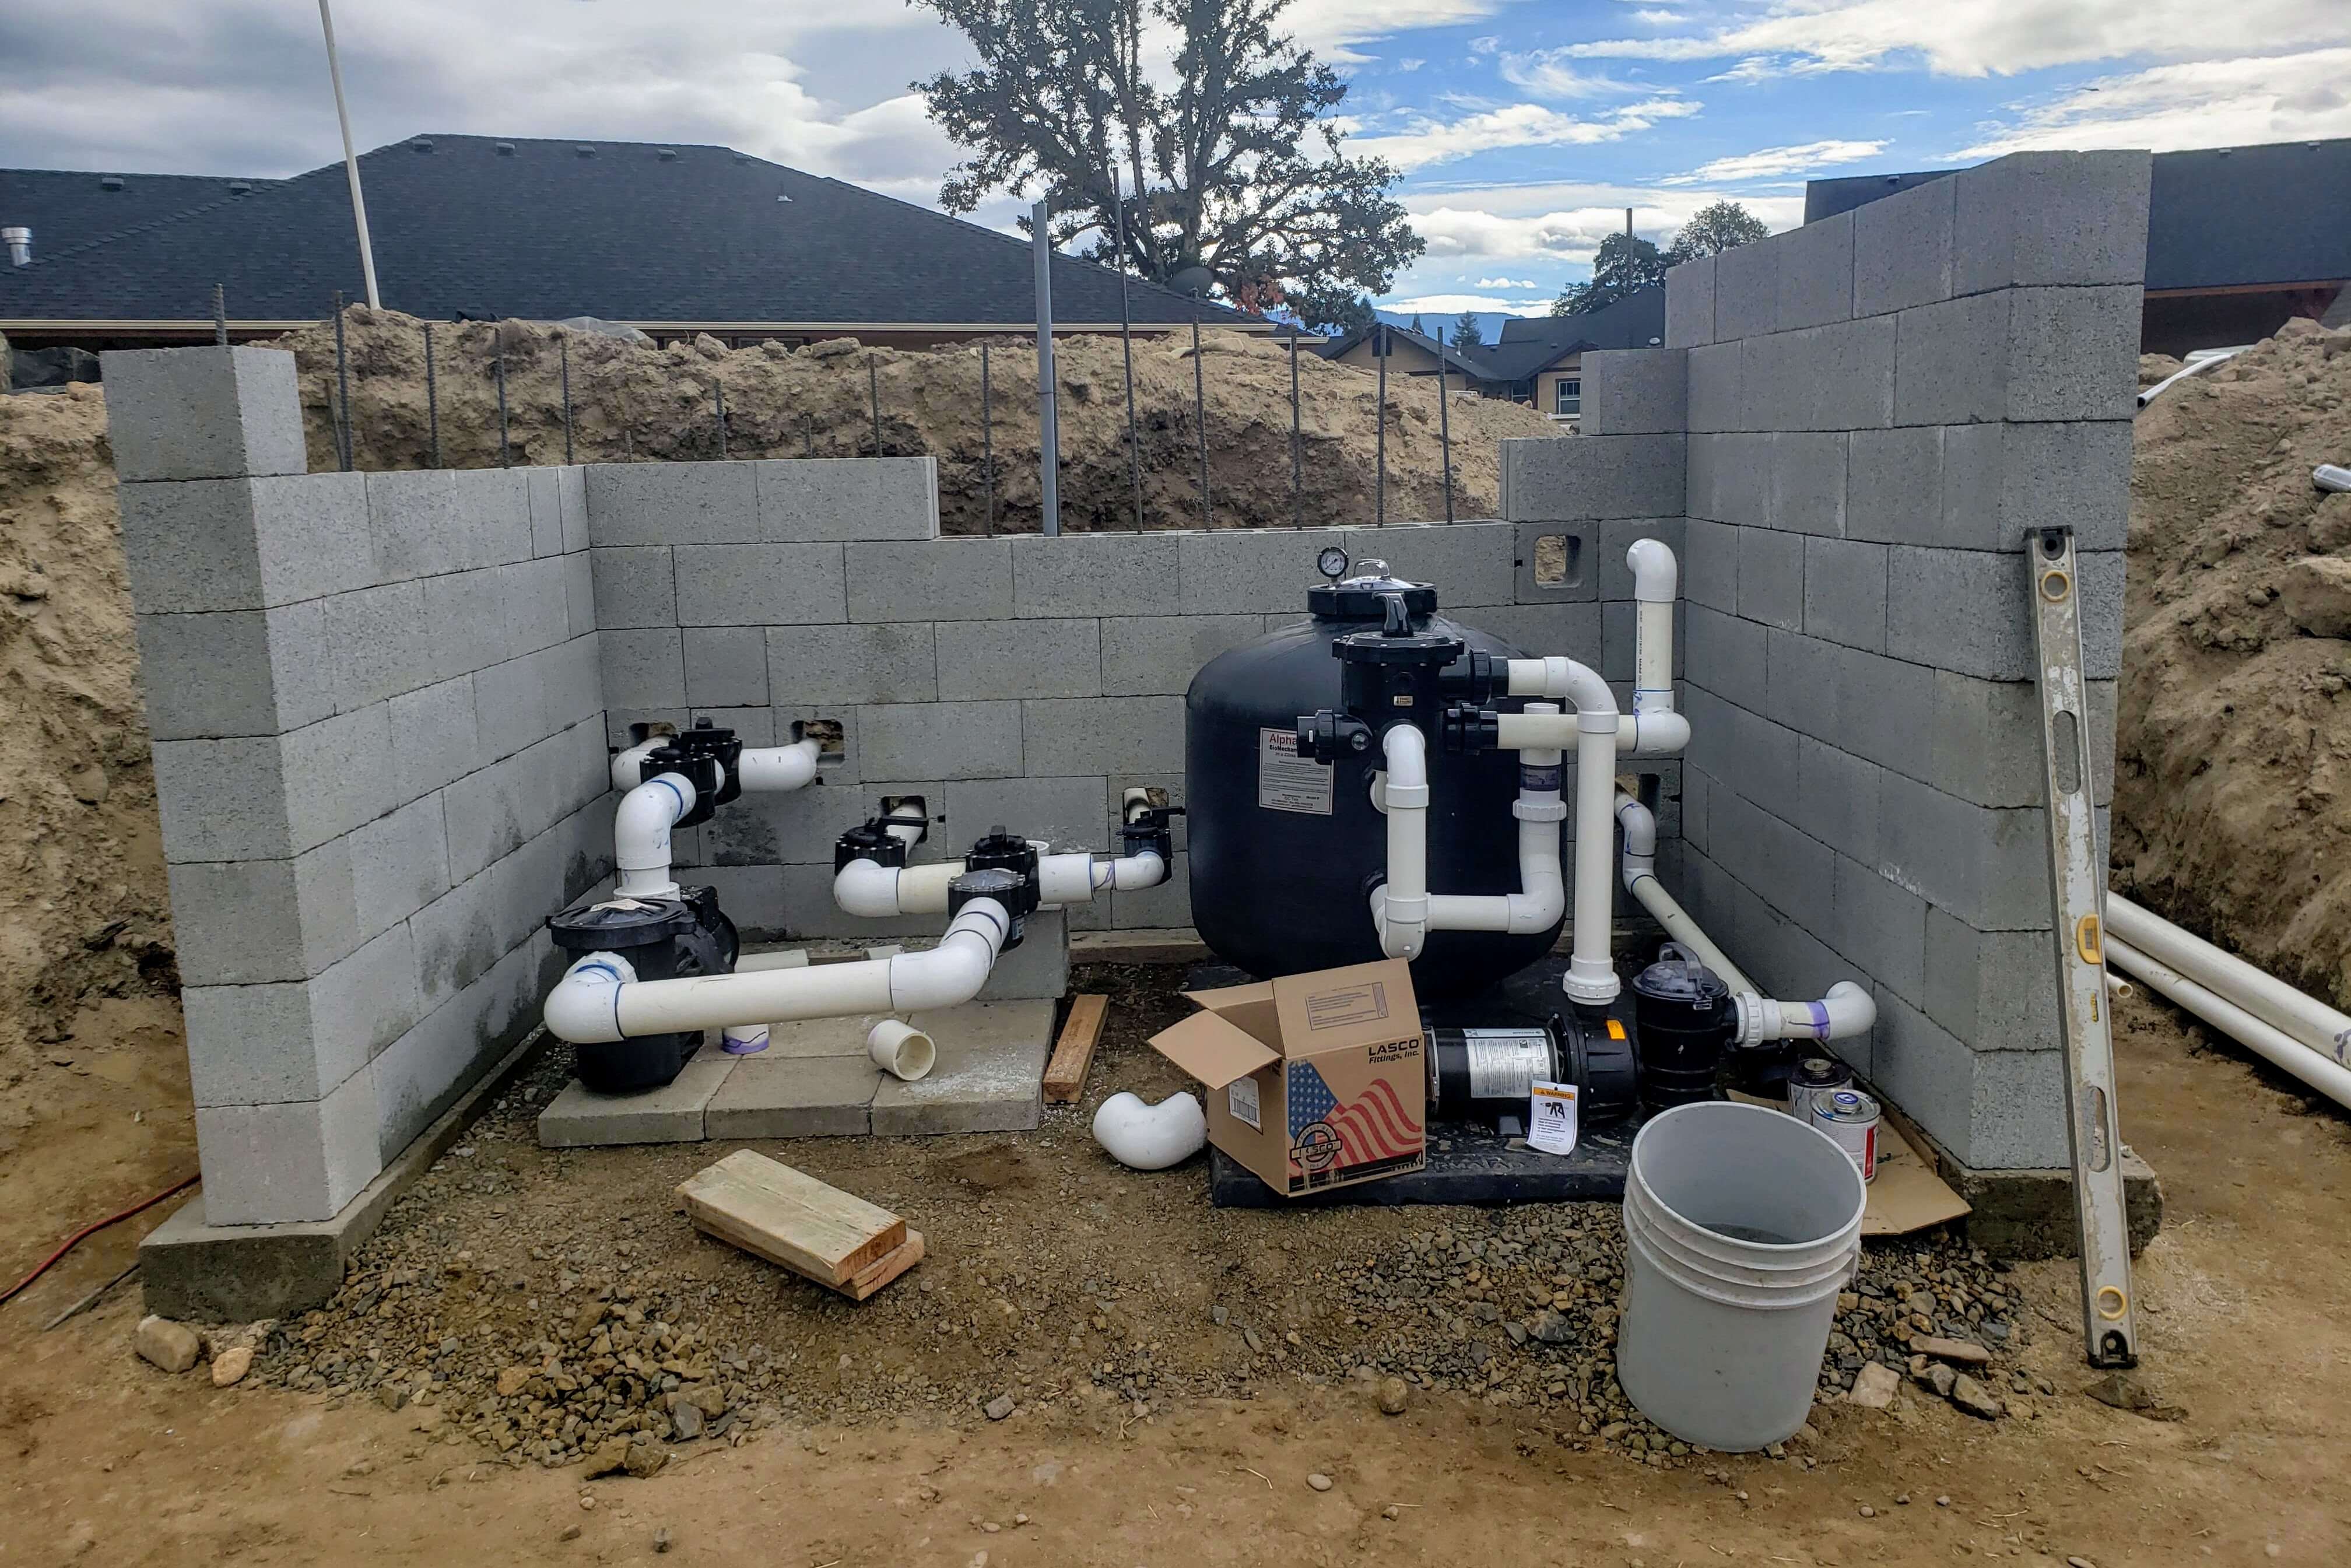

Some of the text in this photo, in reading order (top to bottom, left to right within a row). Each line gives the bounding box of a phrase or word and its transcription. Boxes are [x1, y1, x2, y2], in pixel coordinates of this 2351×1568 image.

[1269, 734, 1297, 746] Alpha
[1369, 1039, 1419, 1056] LASCO
[1369, 1054, 1402, 1064] Fittings,
